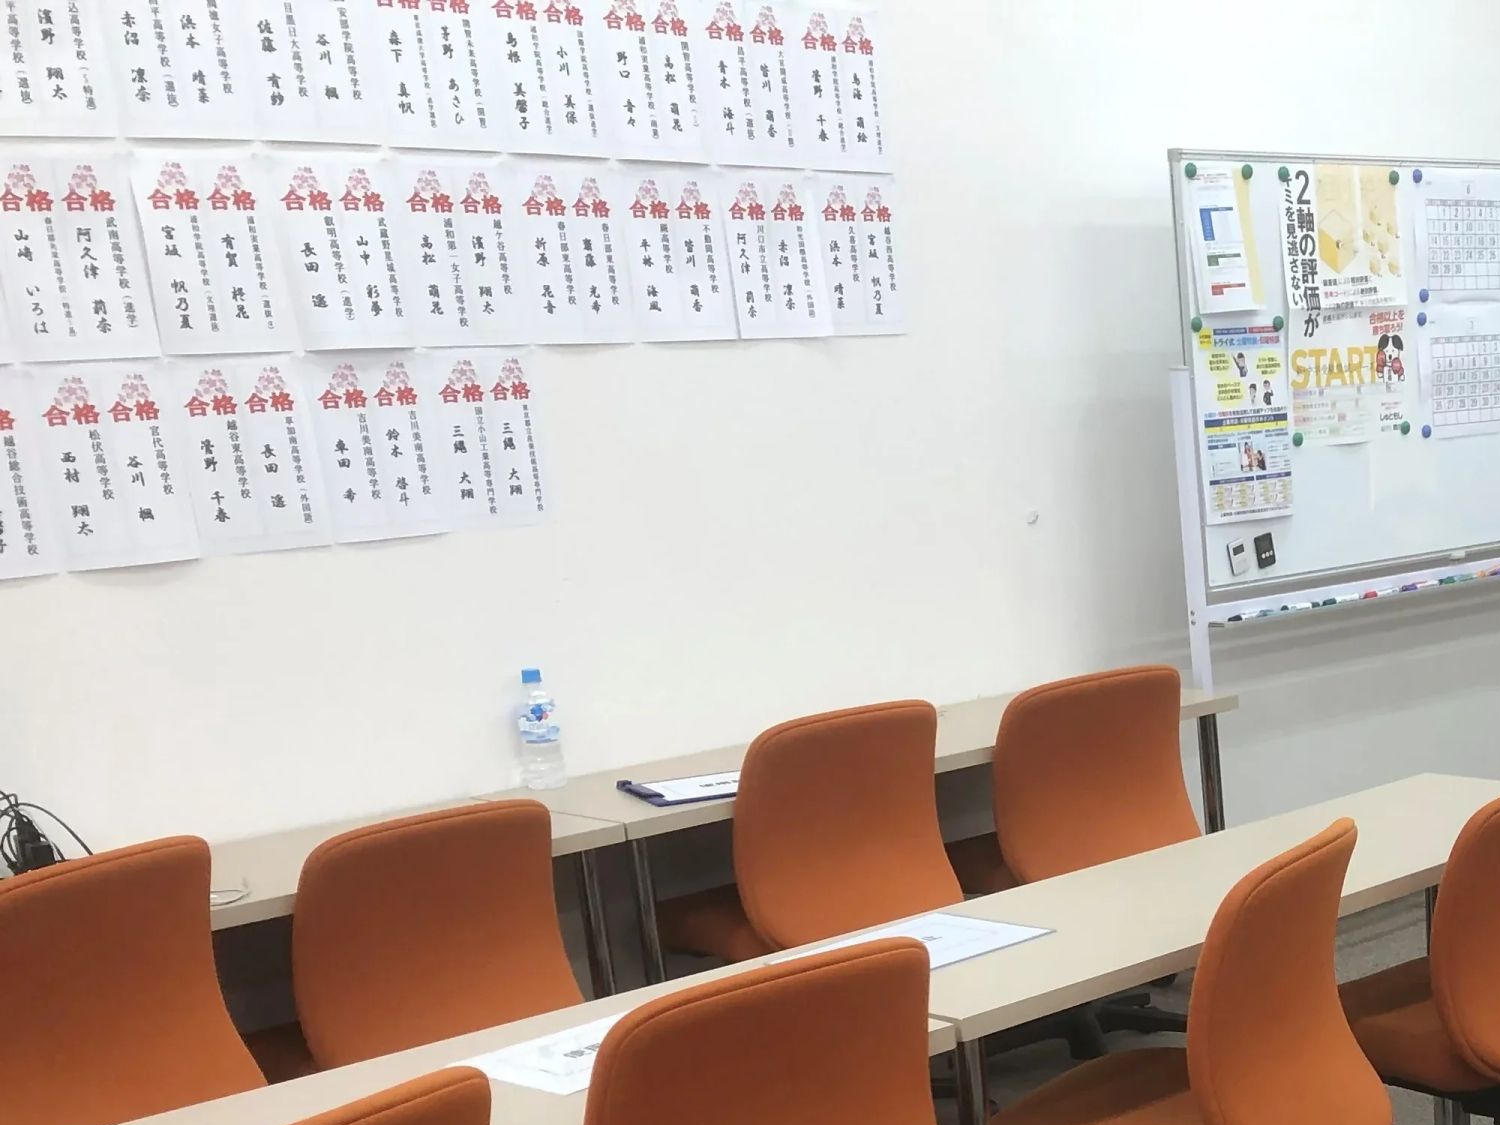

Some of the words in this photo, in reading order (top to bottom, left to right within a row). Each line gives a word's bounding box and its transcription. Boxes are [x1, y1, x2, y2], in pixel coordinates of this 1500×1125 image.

[491, 0, 537, 21] 合格
[543, 3, 583, 26] 合格
[603, 10, 646, 32] 合格
[257, 19, 277, 53] 佐藤
[651, 14, 688, 37] 合格
[705, 21, 744, 42] 合格
[750, 25, 784, 46] 合格
[315, 34, 332, 65] 谷川
[801, 32, 837, 52] 合格
[841, 36, 874, 56] 合格
[556, 46, 570, 76] 小川
[664, 54, 676, 84] 高松
[448, 78, 464, 125] あさひ
[0, 189, 53, 212] 合格
[61, 189, 115, 212] 合格
[147, 188, 199, 210] 合格
[206, 188, 256, 211] 合格
[280, 190, 333, 212] 合格
[339, 190, 385, 212] 合格
[406, 191, 454, 214] 合格
[460, 194, 502, 215] 合格
[522, 196, 566, 217] 合格
[572, 198, 610, 218] 合格
[629, 200, 670, 220] 合格
[675, 201, 711, 220] 合格
[728, 202, 766, 221] 合格
[771, 203, 805, 222] 合格
[821, 204, 856, 222] 合格
[860, 205, 892, 222] 合格
[76, 227, 98, 280] 阿久津
[221, 234, 239, 267] 有賀
[300, 242, 319, 273] 長田
[356, 235, 371, 265] 山中
[420, 234, 437, 266] 高松
[736, 233, 751, 275] 阿久津
[1294, 170, 1321, 338] 2軸の評価が
[443, 217, 469, 328] 浦和第一女子高等学校
[26, 285, 49, 334] いろは
[171, 279, 193, 329] 帆乃夏
[1291, 344, 1379, 390] START
[244, 391, 294, 413] 合格
[318, 389, 367, 410] 合格
[374, 386, 418, 407] 合格
[438, 384, 484, 403] 合格
[489, 381, 531, 401] 合格
[42, 404, 101, 427] 合格
[107, 401, 160, 422] 合格
[184, 395, 237, 417] 合格
[89, 430, 115, 500] 松伏高等学校
[261, 444, 278, 474] 長田
[127, 456, 146, 487] 谷川
[60, 452, 80, 483] 西村
[71, 505, 94, 536] 翔太
[210, 491, 231, 523] 千春
